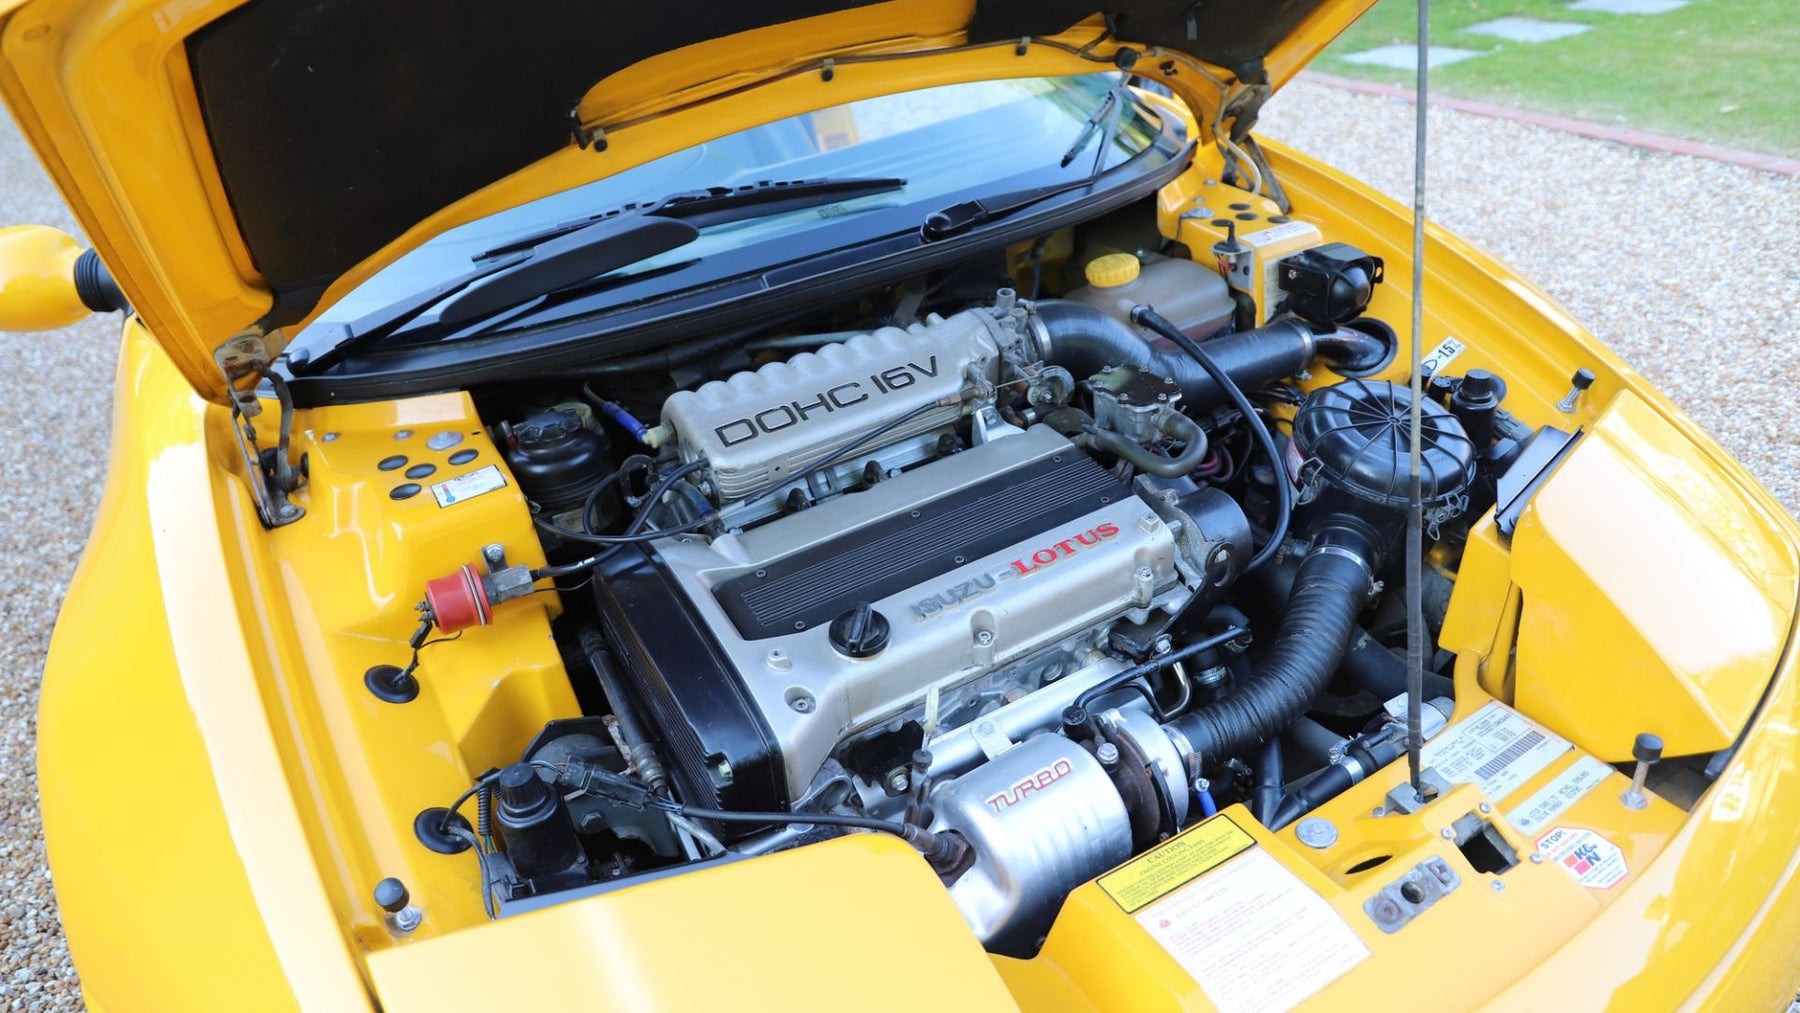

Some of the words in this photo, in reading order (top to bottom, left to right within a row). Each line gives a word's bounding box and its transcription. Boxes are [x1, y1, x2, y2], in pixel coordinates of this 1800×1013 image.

[715, 382, 869, 447] DOHC
[870, 355, 938, 394] 16V
[985, 757, 1073, 812] TURBO
[1146, 840, 1186, 864] CAUTION
